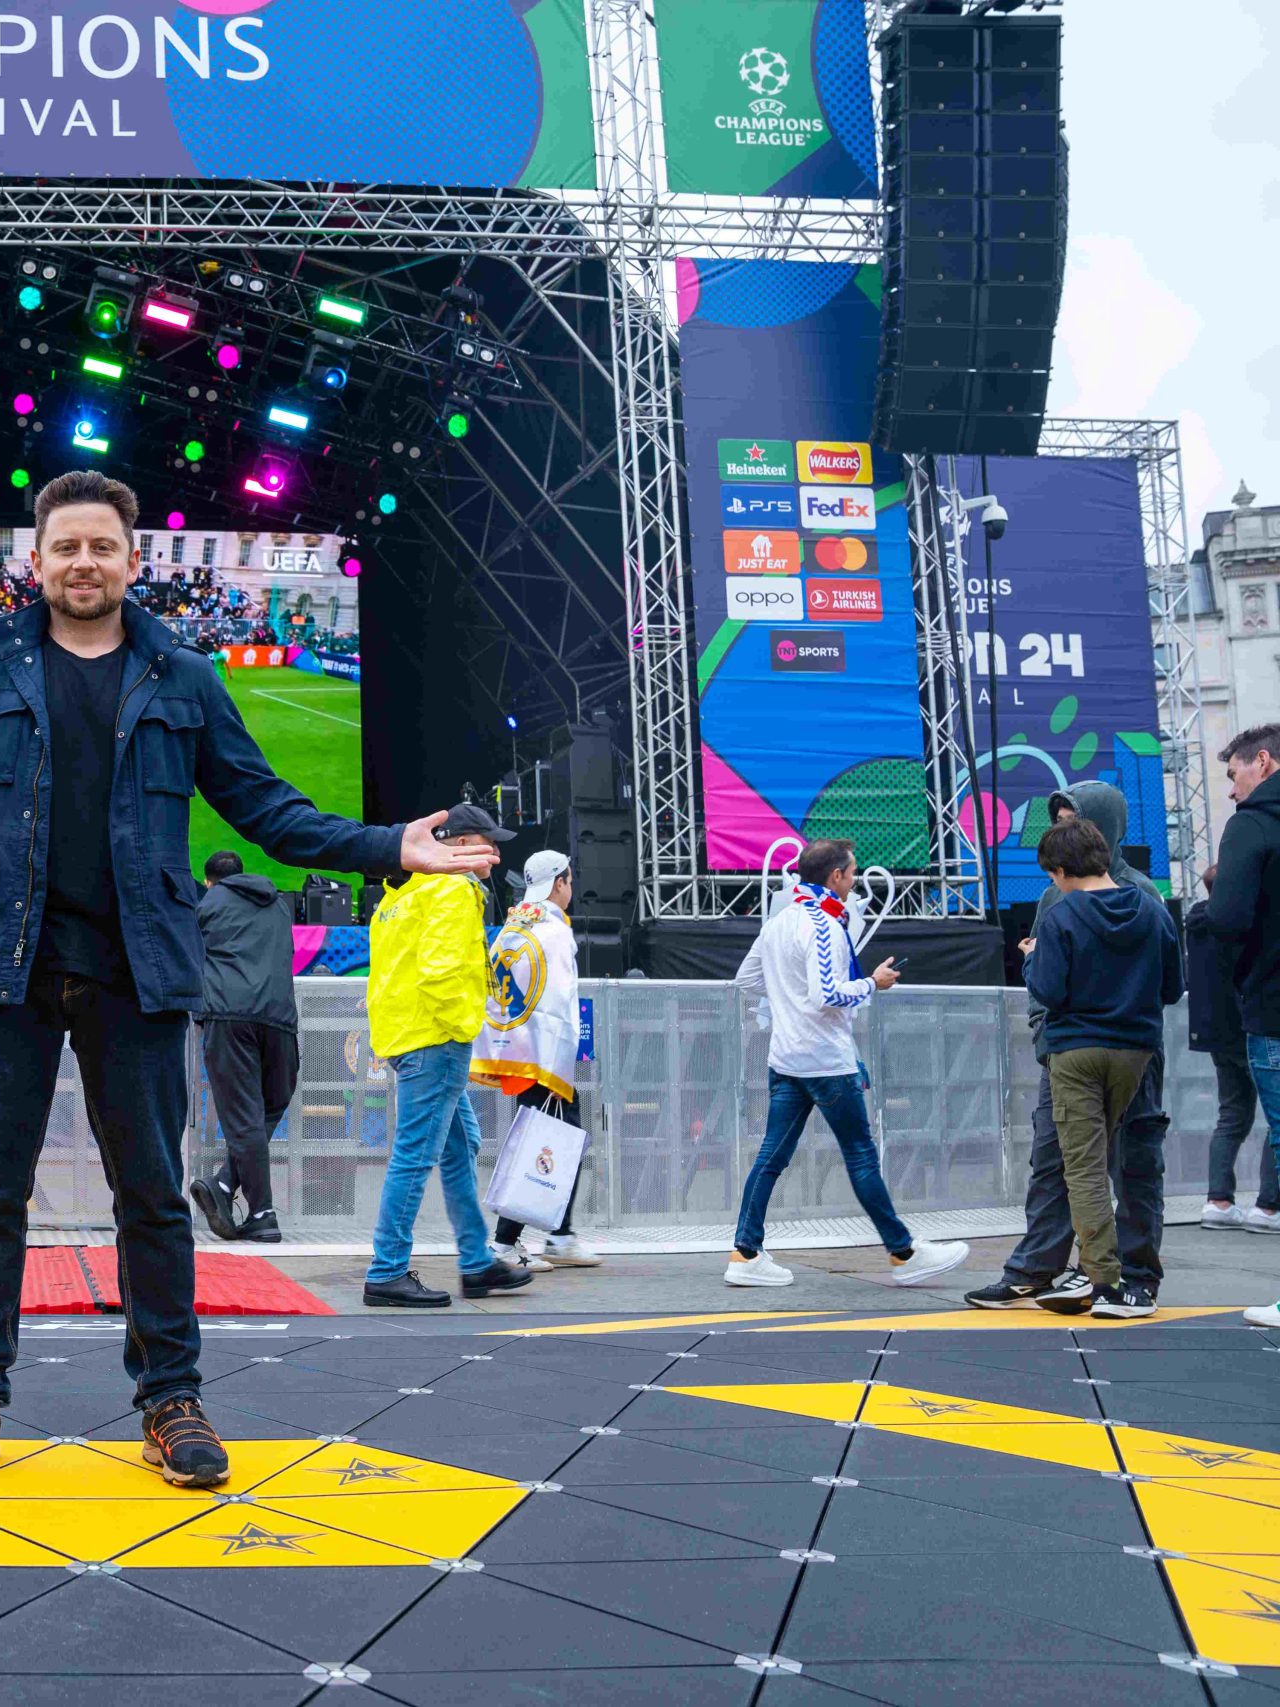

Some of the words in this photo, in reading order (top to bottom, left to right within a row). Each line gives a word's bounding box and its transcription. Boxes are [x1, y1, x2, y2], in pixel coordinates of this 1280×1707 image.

[749, 99, 785, 117] UEFA
[714, 115, 824, 132] CHAMPIONS
[735, 131, 807, 146] LEAGUE
[726, 463, 787, 476] Heineken
[809, 454, 861, 471] WALKERS
[749, 500, 793, 513] PS5
[806, 497, 869, 518] FedEx
[262, 552, 323, 572] UEFA
[737, 558, 764, 570] JUST
[766, 559, 789, 570] EAT
[735, 591, 795, 607] oppo
[832, 590, 876, 600] TURKISH
[832, 600, 878, 610] AIRLINES
[798, 647, 840, 657] SPORTS
[1018, 632, 1085, 678] 24
